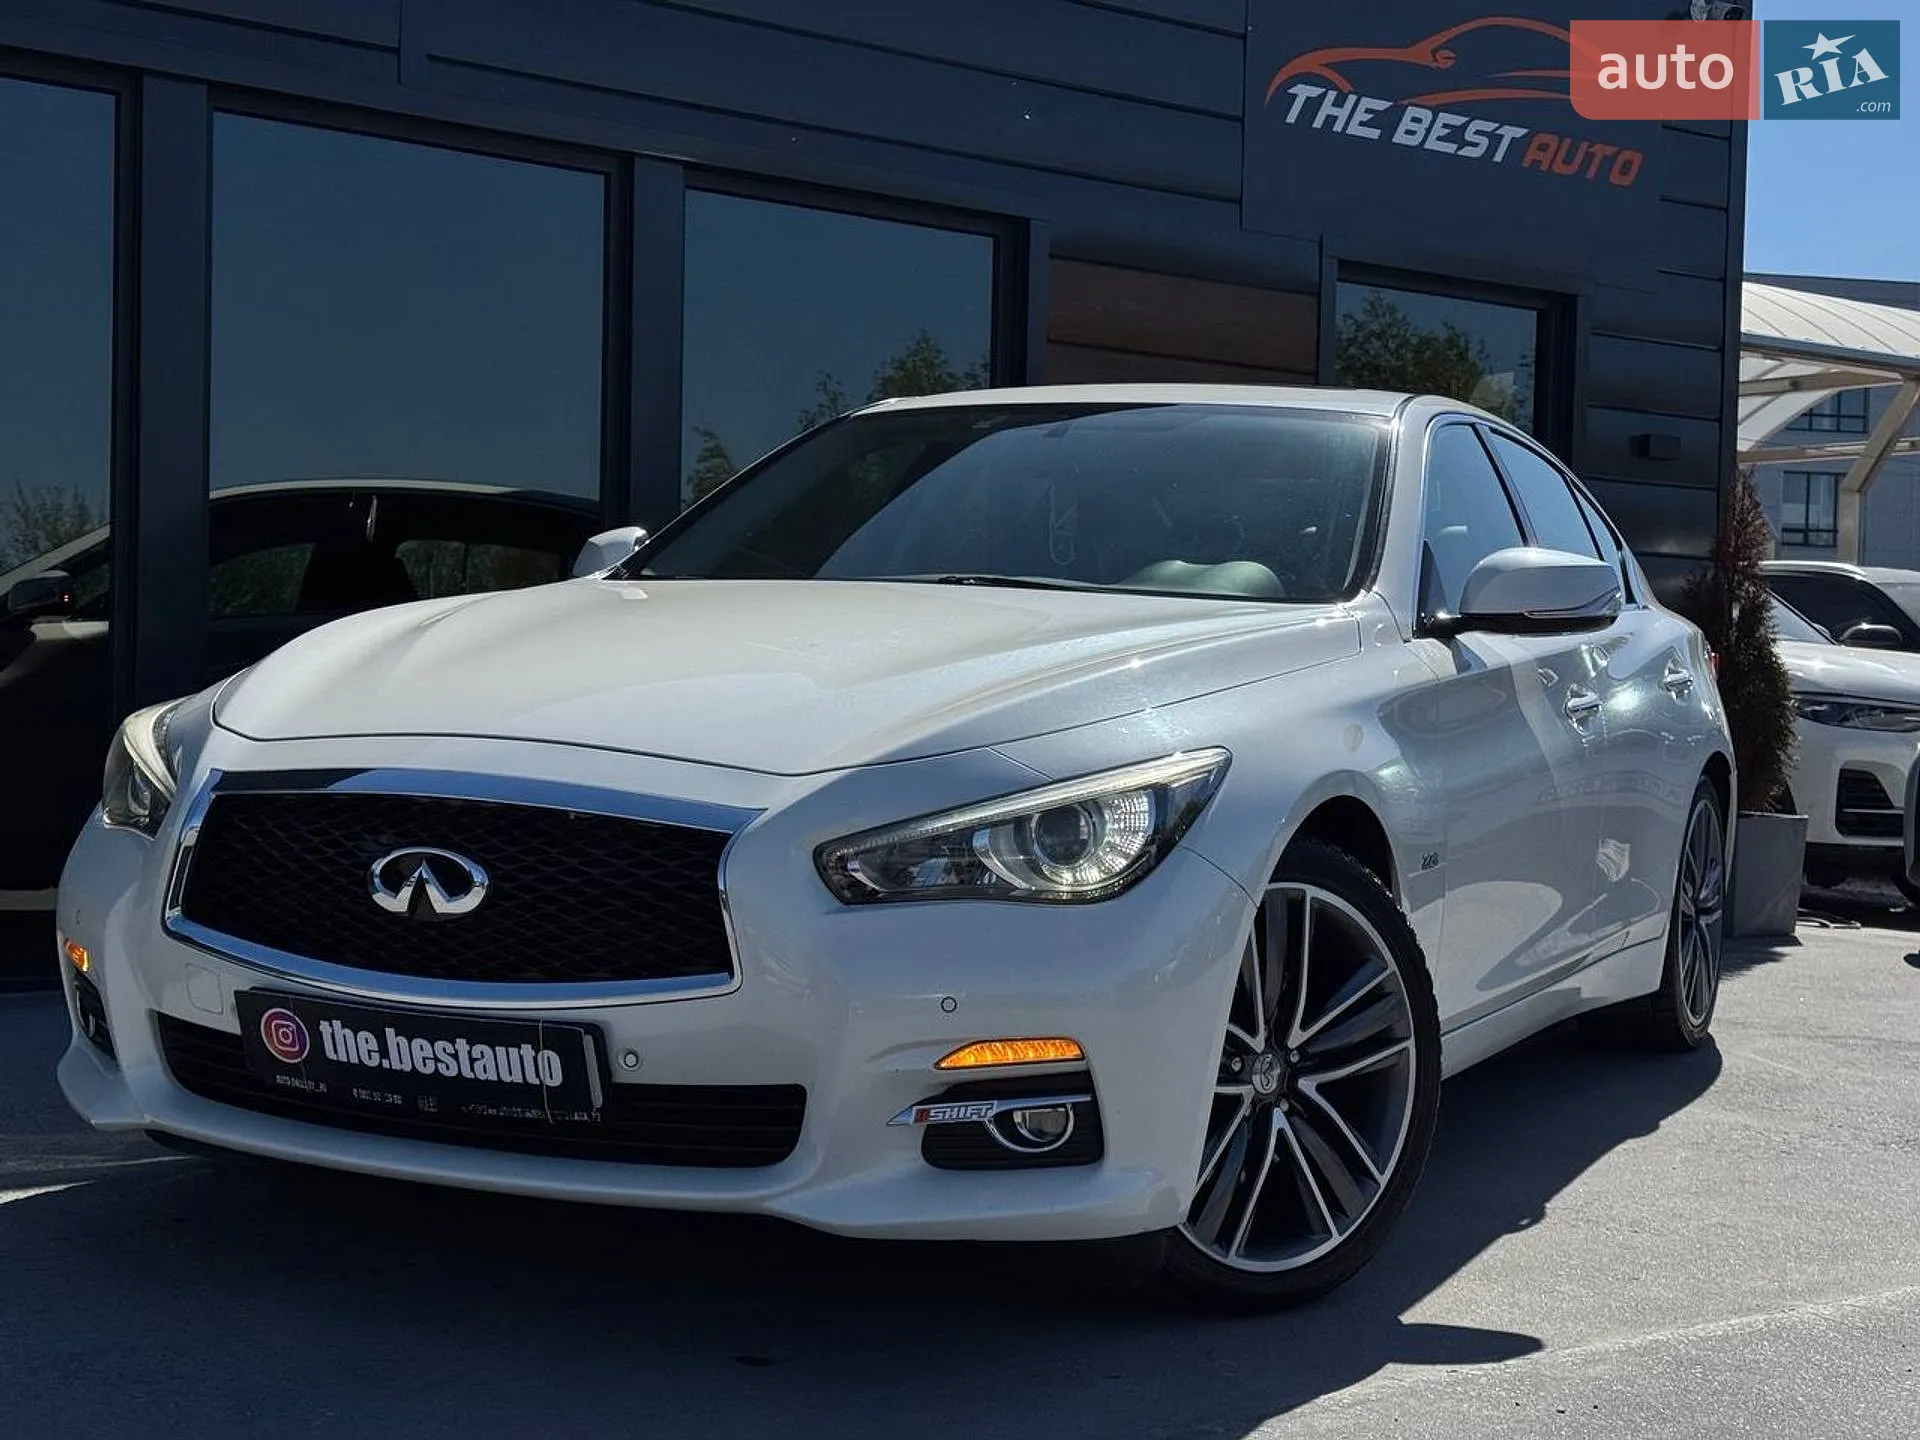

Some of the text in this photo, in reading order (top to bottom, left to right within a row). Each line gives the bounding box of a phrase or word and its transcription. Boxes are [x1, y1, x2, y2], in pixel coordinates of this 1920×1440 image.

[1283, 83, 1645, 187] THE BEST AUTO
[319, 1019, 564, 1088] the.bestauto
